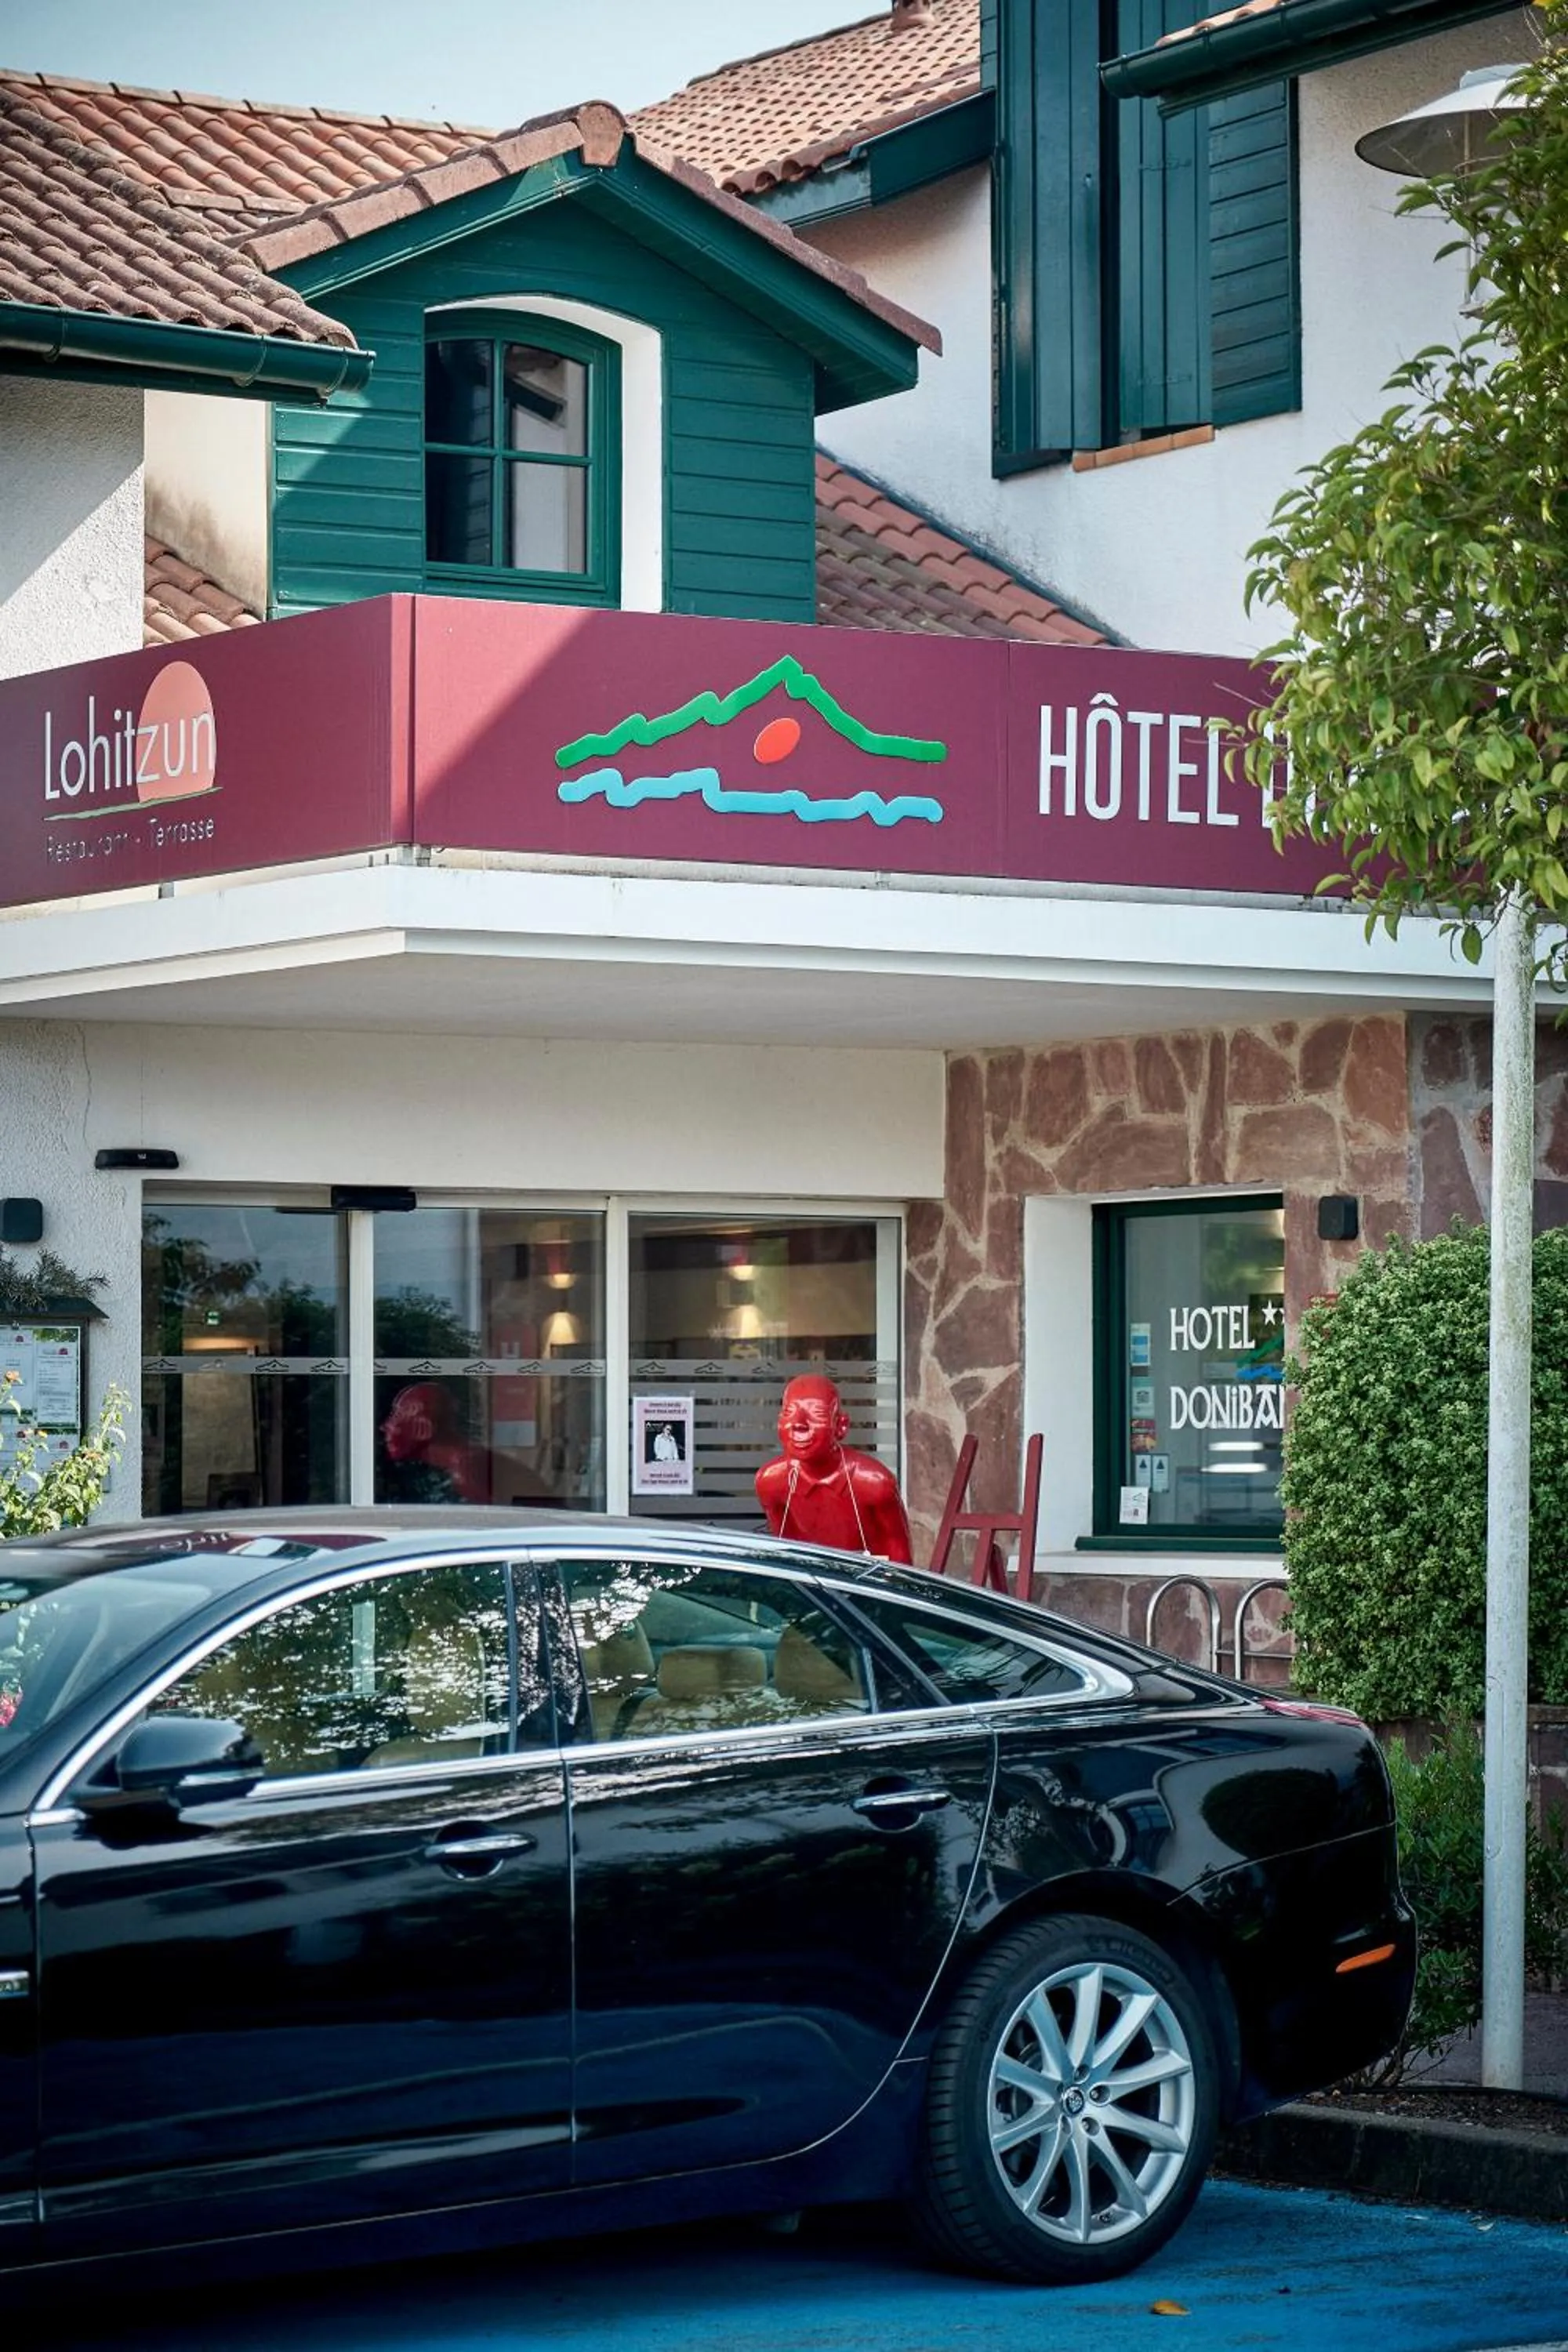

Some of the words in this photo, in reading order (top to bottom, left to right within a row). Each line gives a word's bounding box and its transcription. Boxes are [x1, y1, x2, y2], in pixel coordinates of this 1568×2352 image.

[45, 695, 215, 800] Lohitzun
[1039, 692, 1240, 826] HÔTEL
[1170, 1305, 1255, 1351] HOTEL
